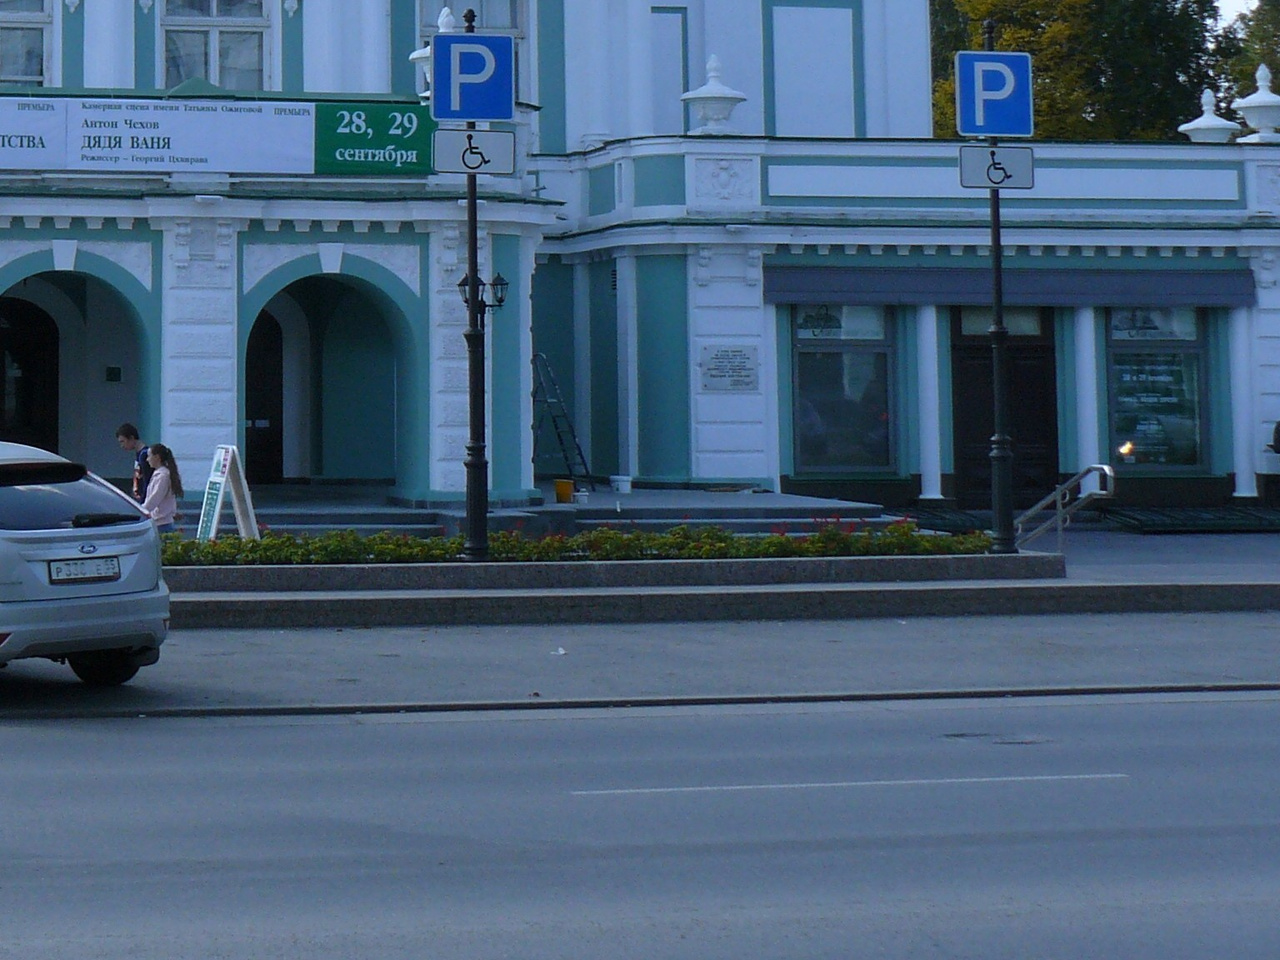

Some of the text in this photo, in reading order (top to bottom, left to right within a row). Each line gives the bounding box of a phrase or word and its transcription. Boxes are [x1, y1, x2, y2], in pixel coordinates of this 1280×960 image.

[451, 43, 496, 111] P
[974, 61, 1015, 127] P
[17, 103, 55, 112] ПРЕМЬЕРА
[81, 102, 122, 112] Камерная
[125, 103, 150, 113] сцена
[153, 104, 180, 112] имени
[183, 104, 217, 113] Татьяны
[274, 107, 311, 116] ПРЕМЬЕРА
[81, 118, 160, 130] Антон Чехов
[336, 111, 418, 139] 28, 29
[81, 135, 172, 150] ДЯДЯ ВАНЯ
[81, 153, 120, 163] Режиссер
[131, 154, 165, 165] Георгий
[335, 145, 418, 167] сентября
